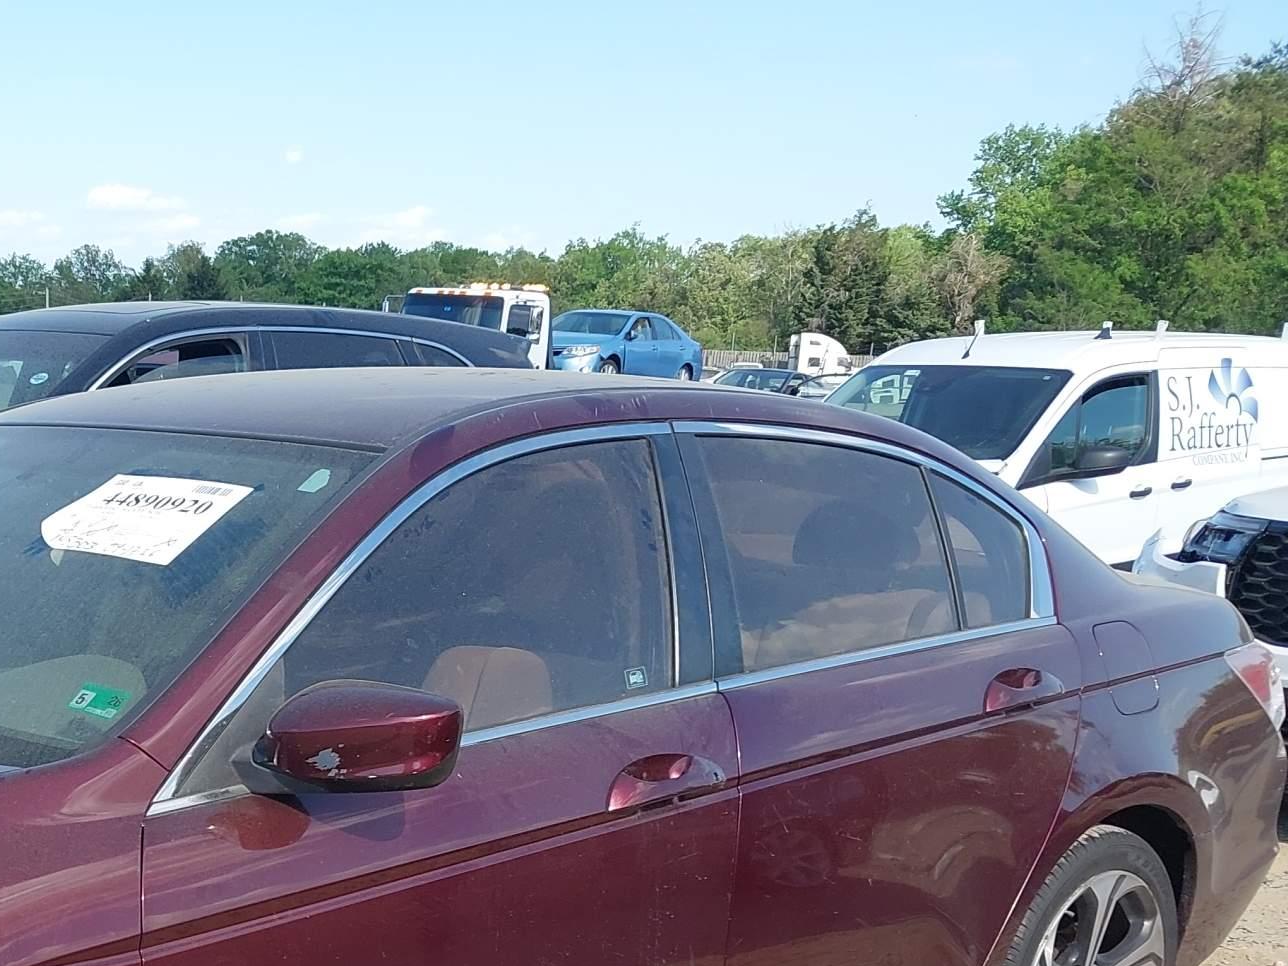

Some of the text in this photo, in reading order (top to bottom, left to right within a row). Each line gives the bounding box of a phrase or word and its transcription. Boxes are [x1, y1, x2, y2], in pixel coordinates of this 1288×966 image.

[1167, 376, 1200, 418] S.J.
[1169, 411, 1254, 459] Rafferty
[102, 491, 214, 515] 44890920
[75, 693, 89, 705] 5
